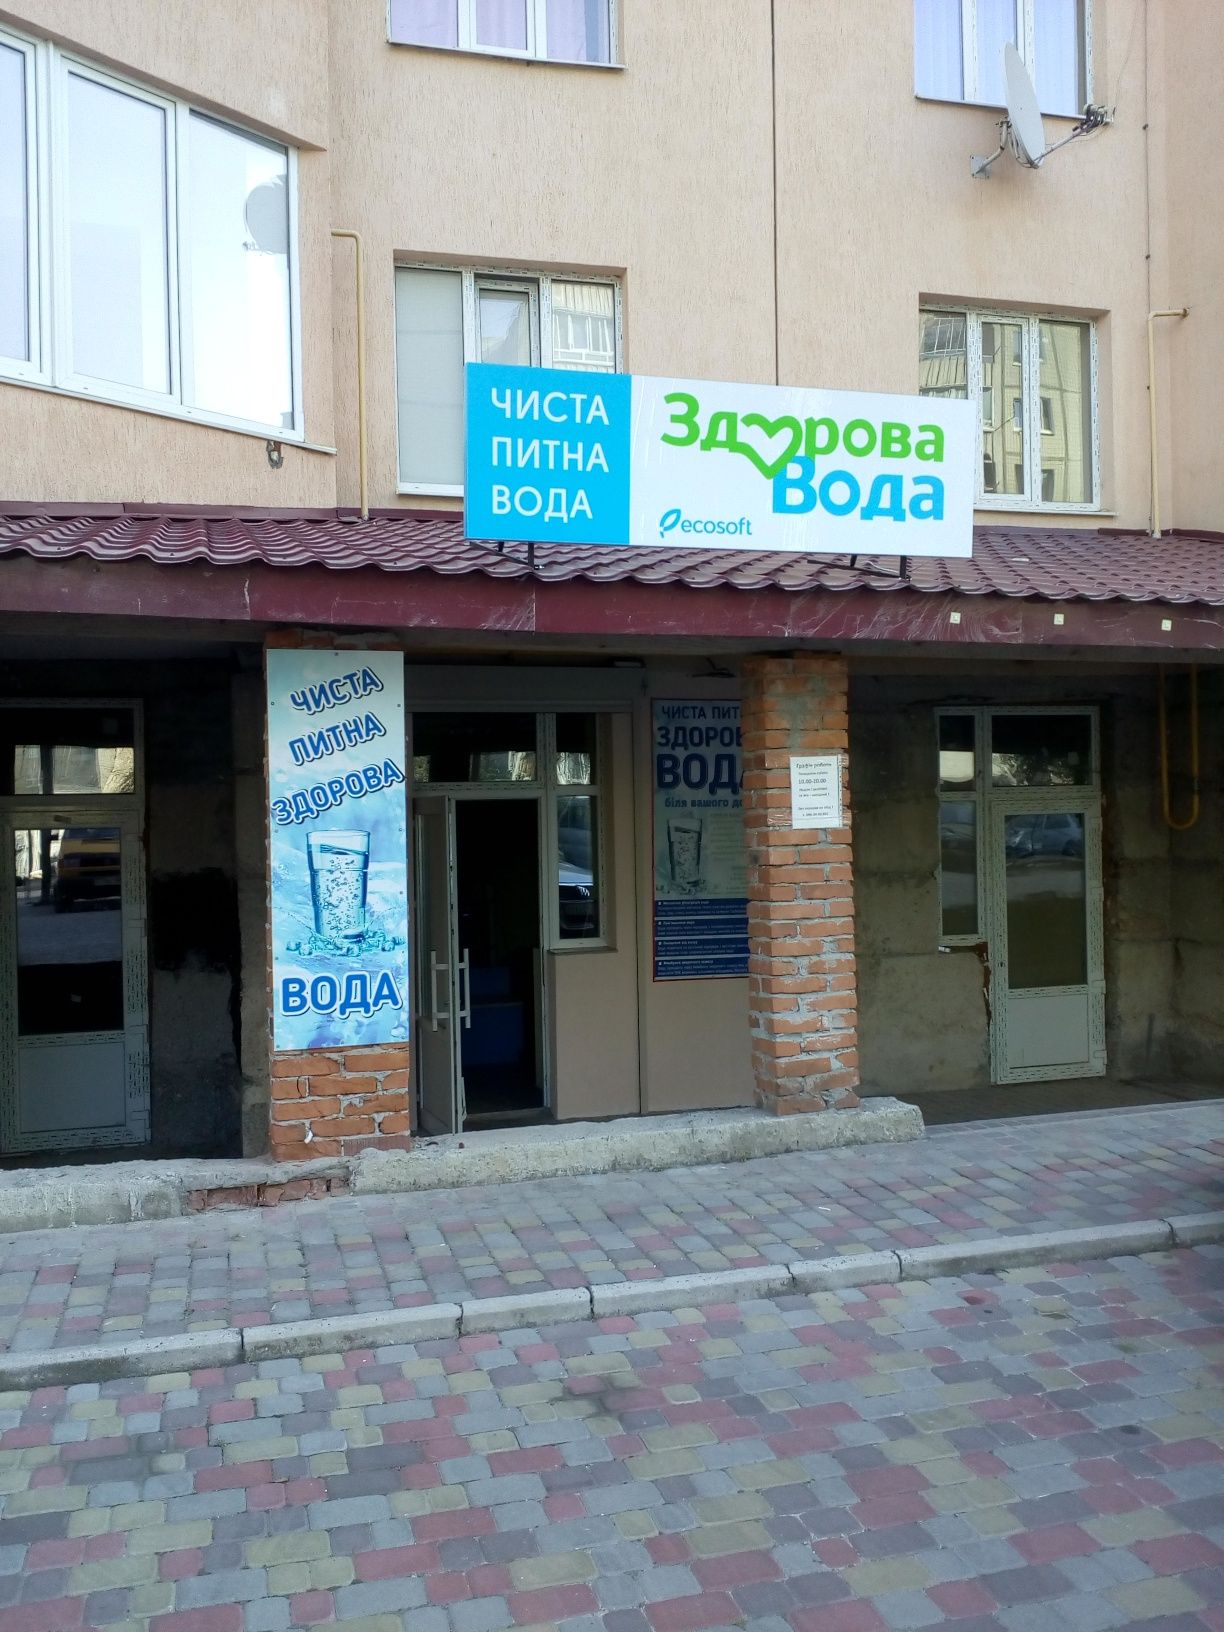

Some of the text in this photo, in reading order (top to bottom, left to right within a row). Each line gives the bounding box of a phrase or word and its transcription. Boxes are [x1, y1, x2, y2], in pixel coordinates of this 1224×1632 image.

[491, 387, 610, 425] ЧИСТА
[491, 436, 610, 473] ПИТНА
[491, 484, 593, 523] ВОДА
[772, 455, 944, 522] Вода
[681, 517, 752, 535] ecosoft
[290, 667, 384, 715] ЧИСТА
[662, 705, 743, 719] ЧИСТА ПИТ
[288, 712, 386, 765] ПИТНА
[271, 758, 405, 825] ЗДОРОВА
[656, 753, 744, 795] ВОД
[664, 797, 687, 807] біля
[691, 799, 729, 807] вашого
[281, 970, 403, 1019] ВОДА
